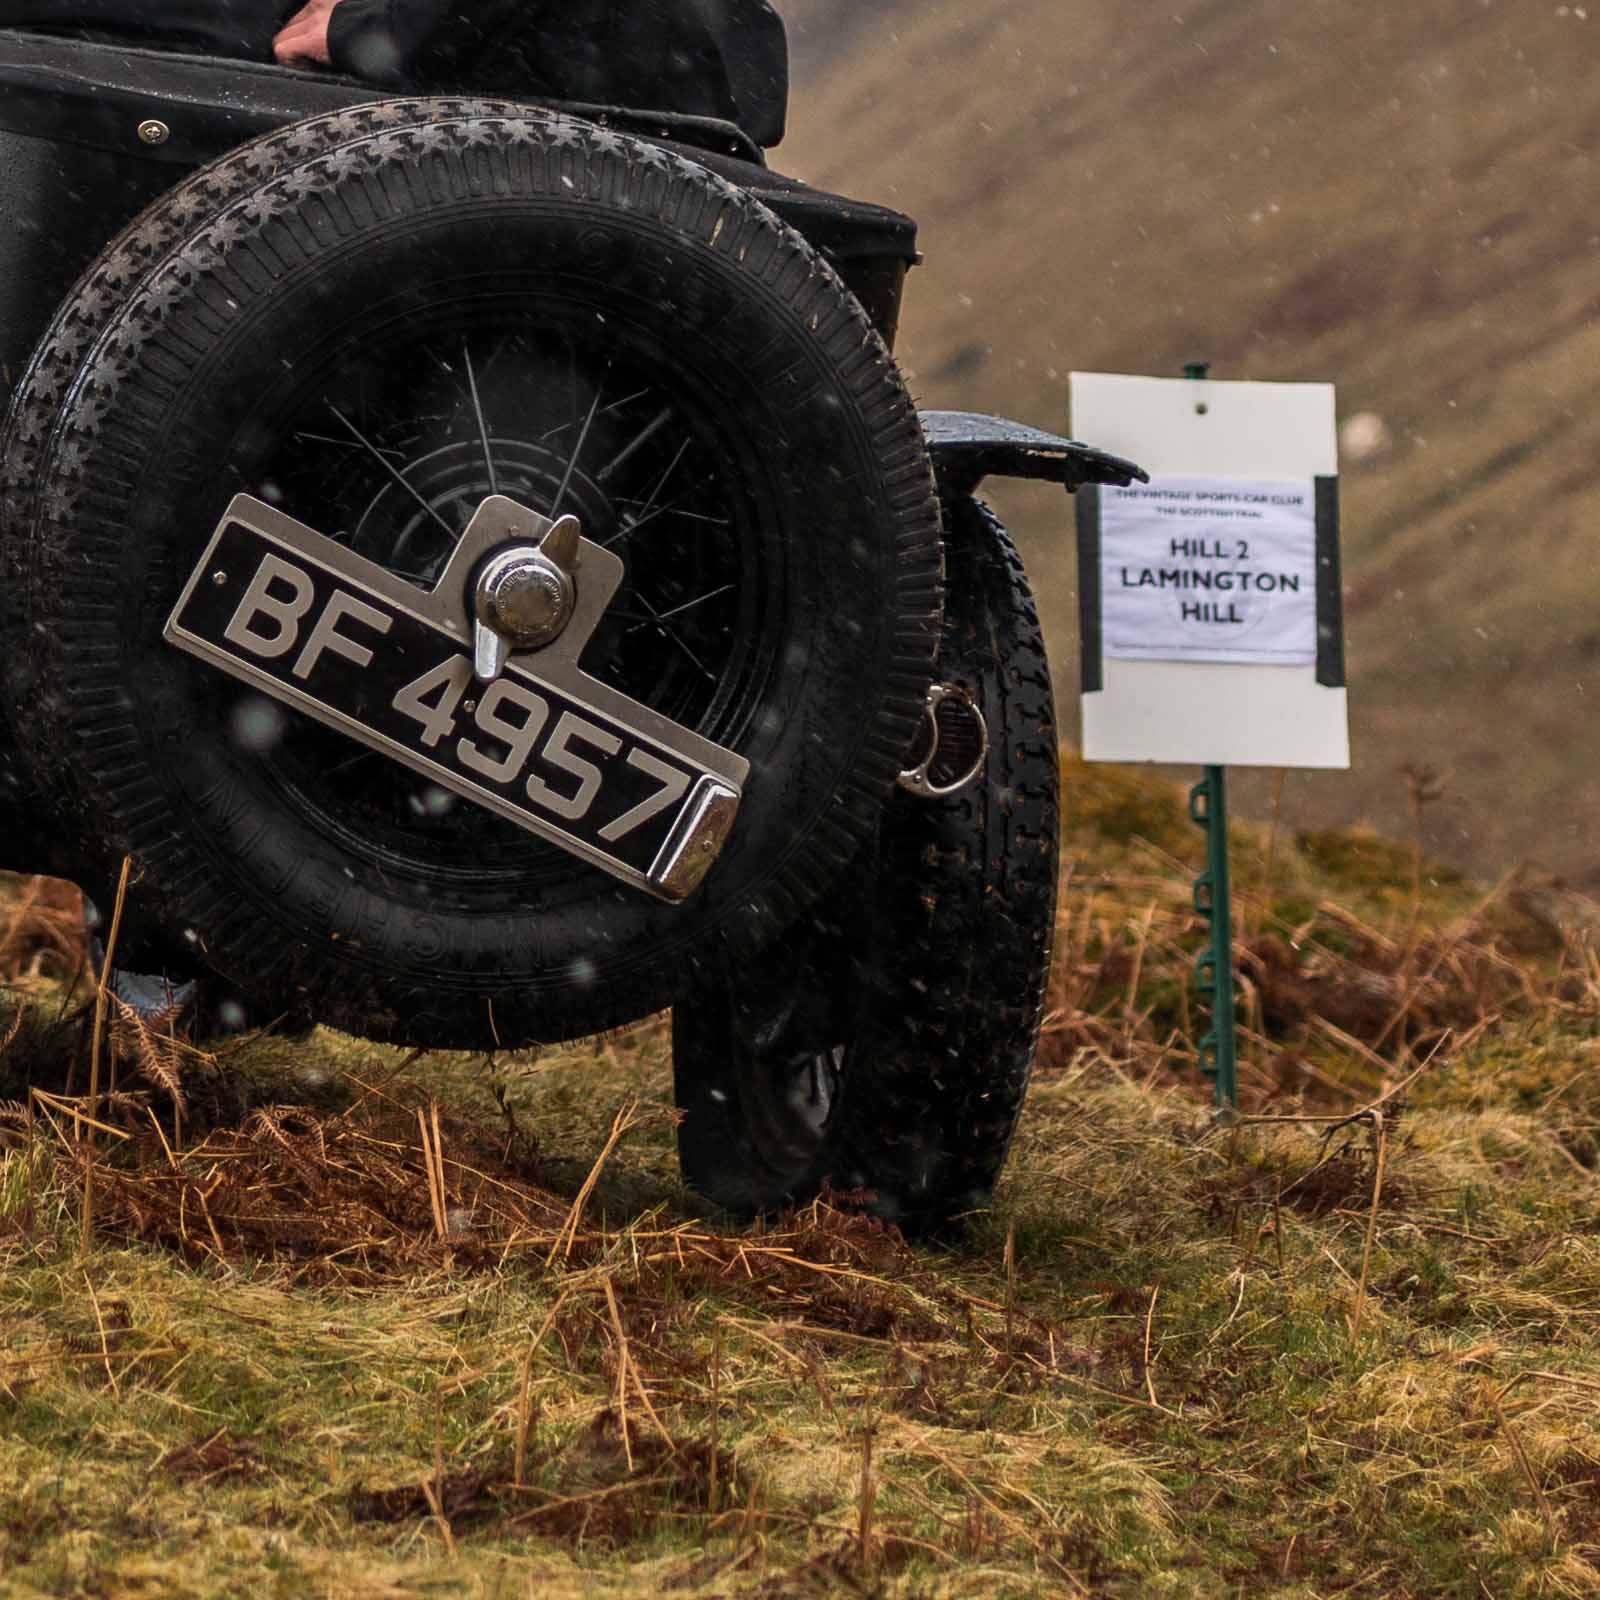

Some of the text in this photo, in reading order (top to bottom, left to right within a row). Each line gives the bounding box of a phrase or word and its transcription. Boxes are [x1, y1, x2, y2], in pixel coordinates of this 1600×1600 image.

[1170, 538, 1250, 559] HILL 2
[1120, 566, 1300, 593] LAMINGTON
[1180, 601, 1245, 624] HILL
[224, 552, 394, 680] BF
[391, 653, 692, 843] 4957
